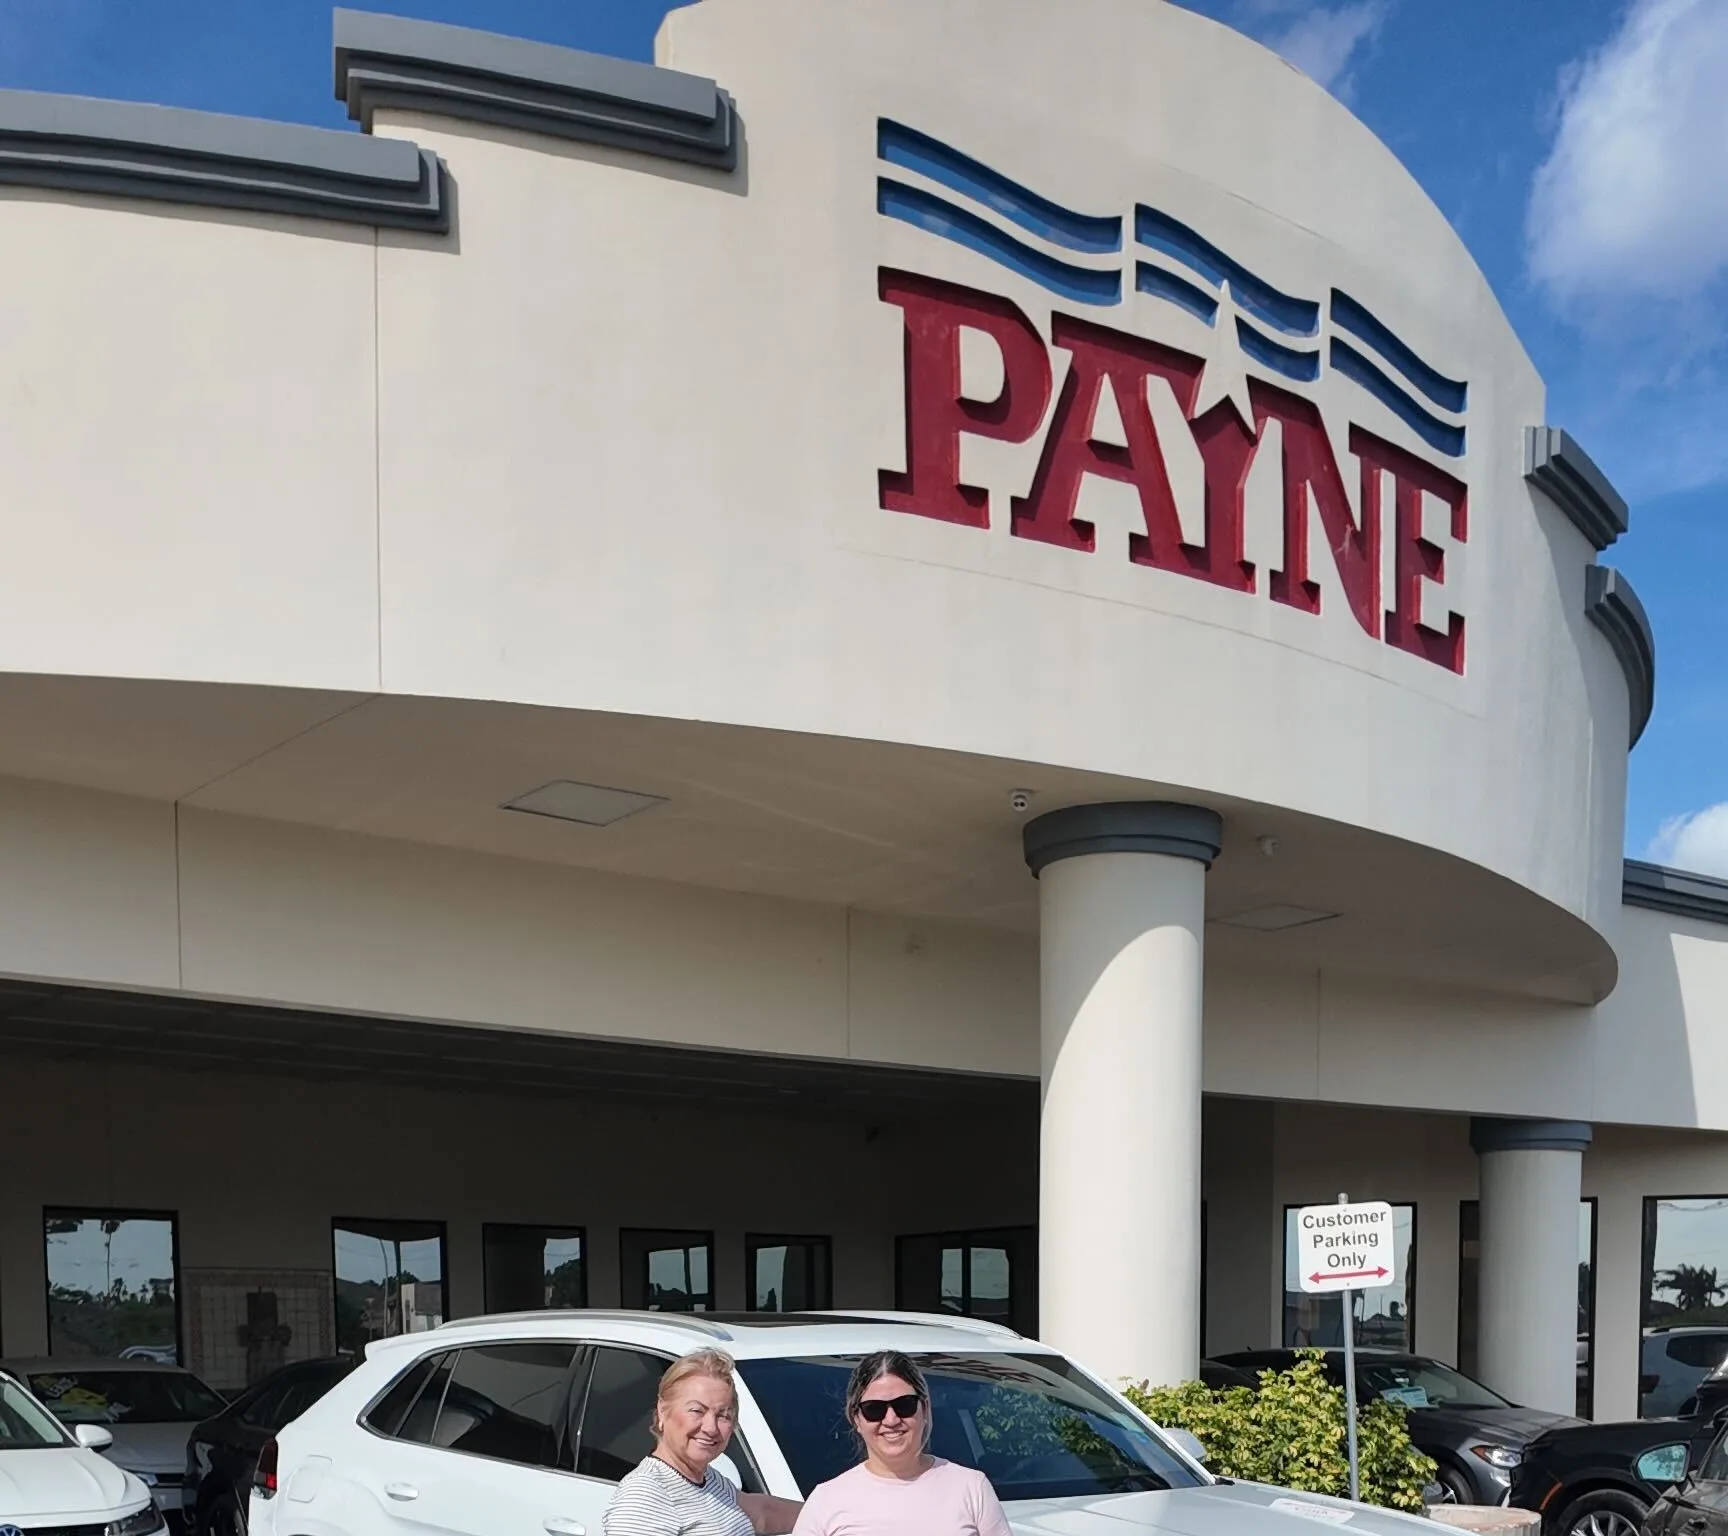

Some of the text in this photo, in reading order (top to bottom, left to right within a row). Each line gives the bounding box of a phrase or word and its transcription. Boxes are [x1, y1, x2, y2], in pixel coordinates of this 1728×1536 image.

[877, 265, 1468, 677] PAYNE
[1302, 1210, 1387, 1229] Customer
[1312, 1231, 1379, 1248] Parking
[1327, 1252, 1367, 1269] Only
